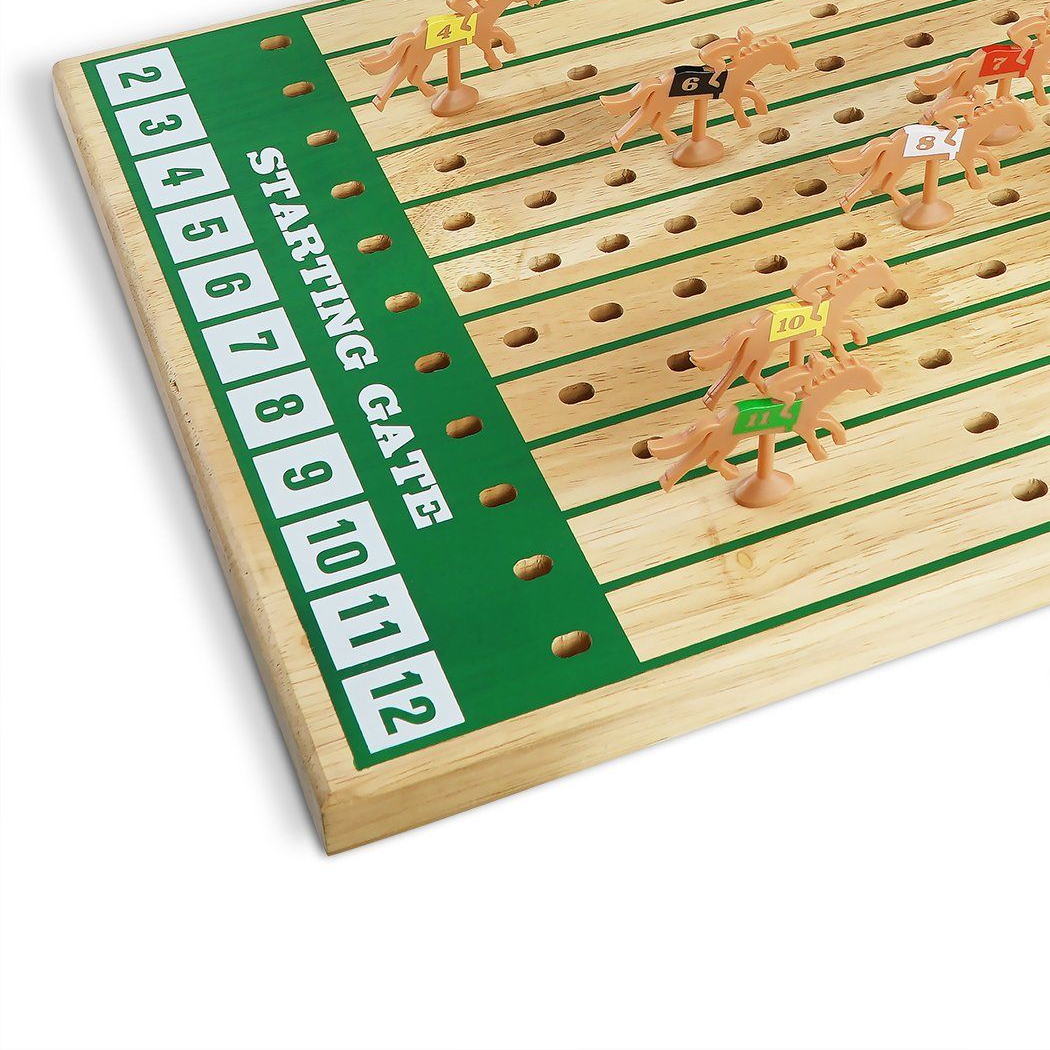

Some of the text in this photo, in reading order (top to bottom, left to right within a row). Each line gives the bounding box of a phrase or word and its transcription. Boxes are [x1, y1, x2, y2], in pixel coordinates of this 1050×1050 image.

[436, 24, 453, 40] 4
[992, 55, 1007, 70] 7
[117, 66, 162, 89] 2
[682, 76, 699, 92] 6
[138, 114, 183, 136] 3
[915, 135, 936, 151] 8
[161, 166, 205, 188] 4
[181, 216, 229, 242] 5
[204, 272, 251, 298] 6
[776, 314, 805, 333] 10
[228, 329, 279, 353] 7
[246, 147, 454, 530] STARTING GATE
[255, 393, 304, 422] 8
[745, 411, 772, 427] 11
[282, 460, 333, 492] 9
[306, 518, 369, 575] 10
[337, 593, 402, 649] 11
[369, 670, 437, 736] 12
